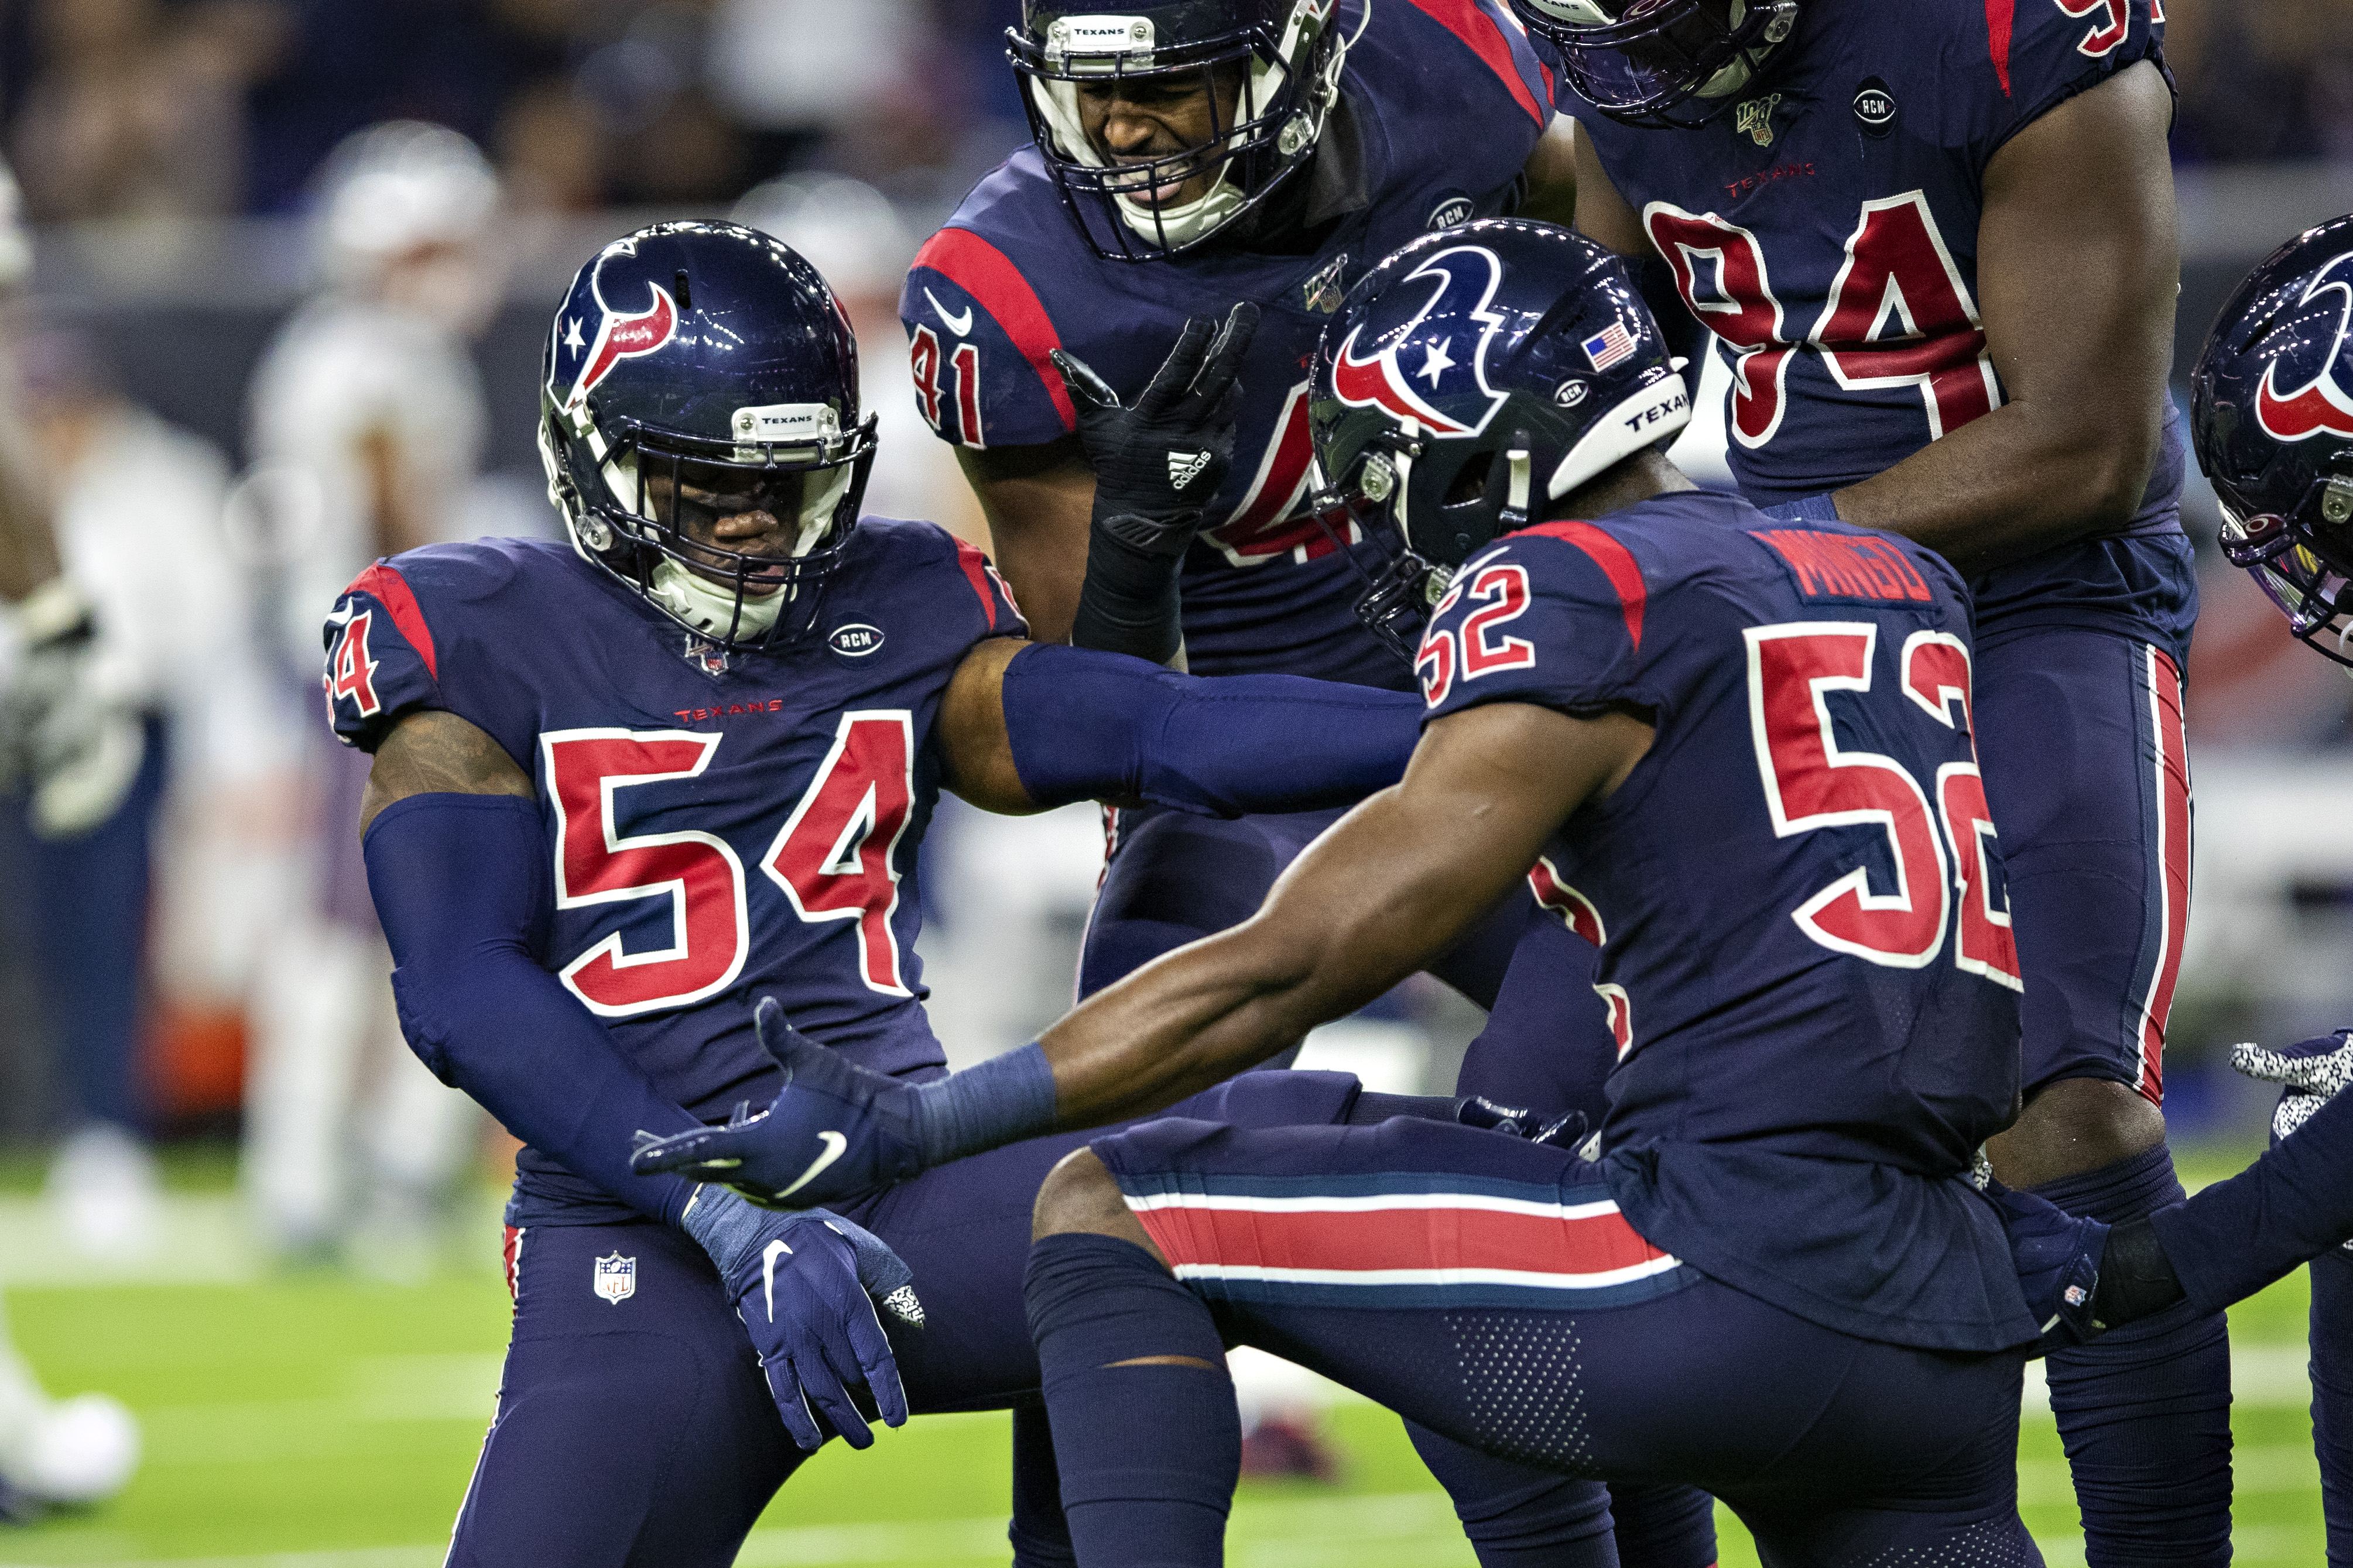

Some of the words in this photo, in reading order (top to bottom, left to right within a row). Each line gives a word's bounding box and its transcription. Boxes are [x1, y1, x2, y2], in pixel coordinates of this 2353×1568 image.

[2052, 0, 2166, 57] 9
[1862, 99, 1885, 114] RCM
[1724, 163, 1814, 198] TEXANS
[1643, 189, 2001, 449] 94
[910, 322, 987, 450] 41
[1625, 394, 1689, 433] TEXAN
[762, 416, 812, 424] TEXANS
[1173, 451, 1211, 489] adidas
[1198, 379, 1364, 568] 4
[840, 632, 872, 649] RCM
[1413, 564, 1536, 709] 52
[324, 609, 381, 733] 4
[674, 699, 782, 723] TEXANS
[1742, 621, 2024, 993] 52
[540, 709, 917, 1017] 54
